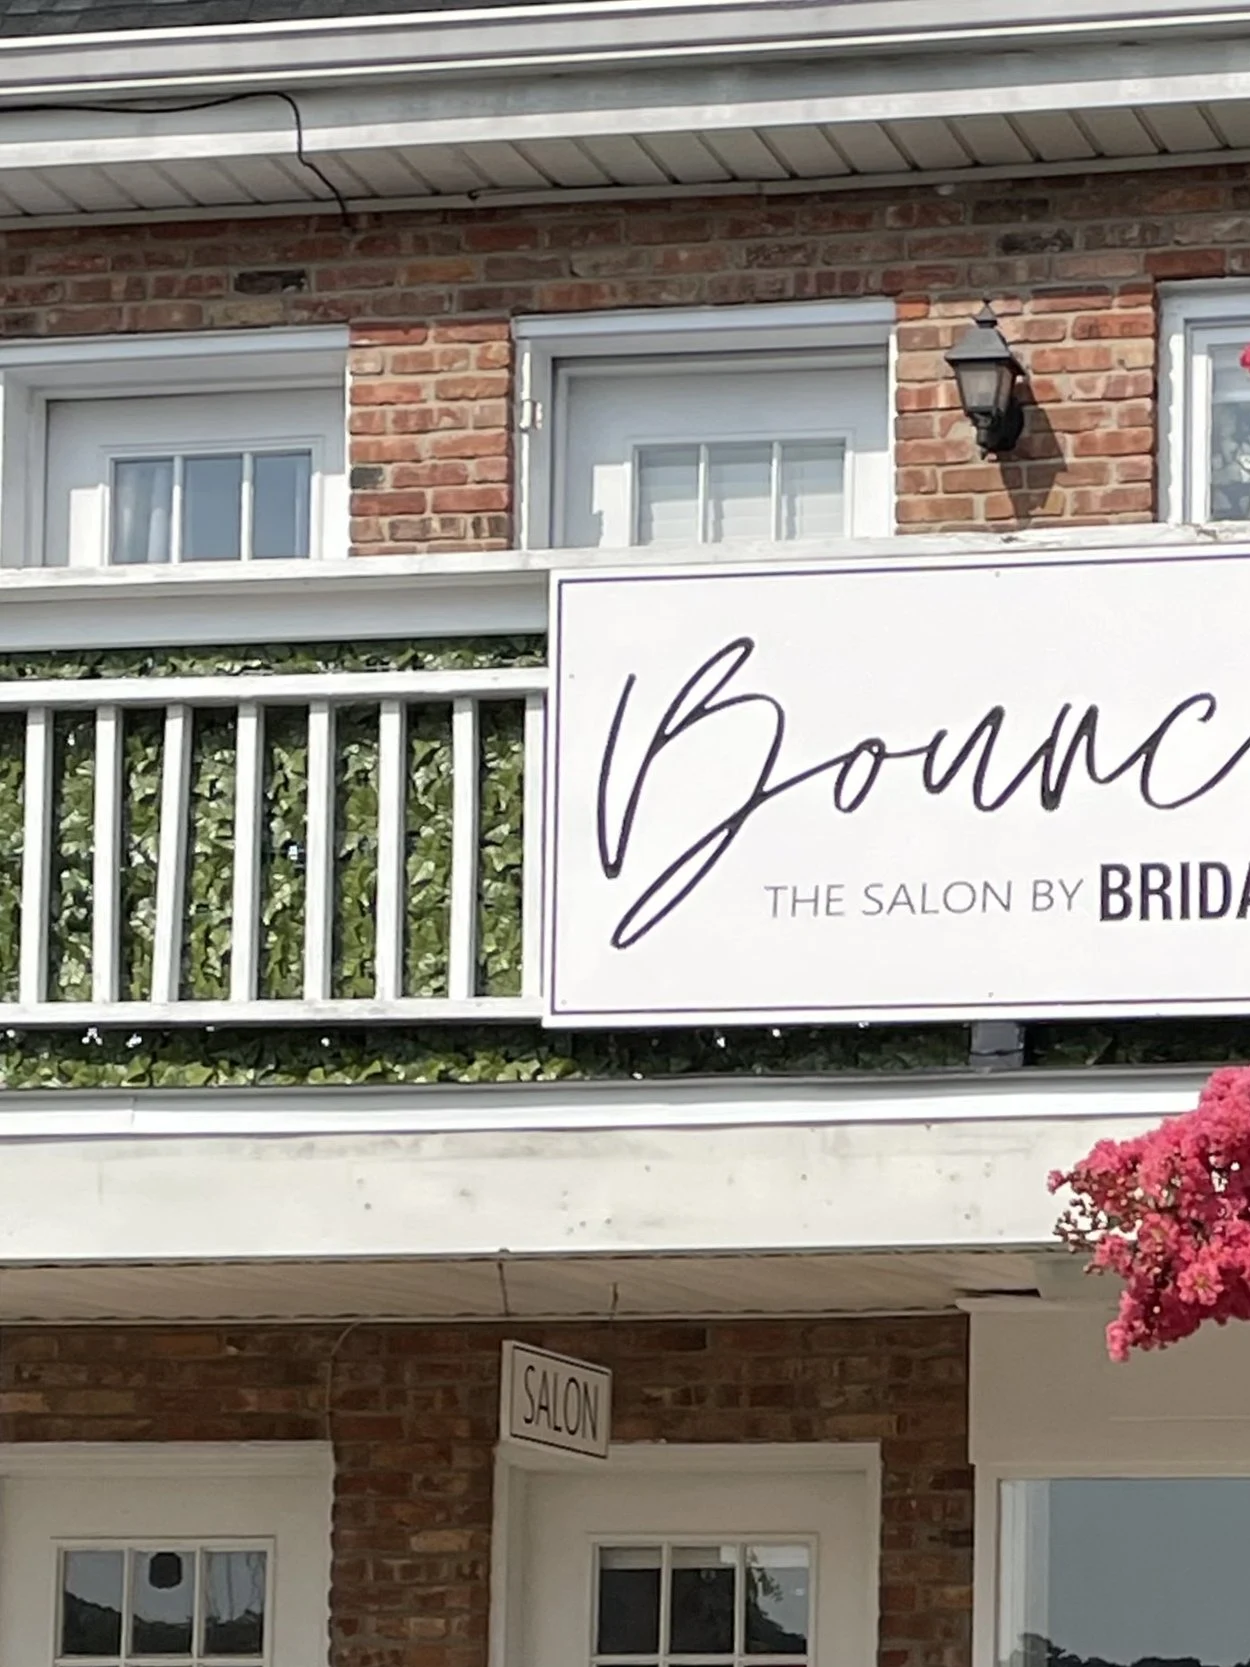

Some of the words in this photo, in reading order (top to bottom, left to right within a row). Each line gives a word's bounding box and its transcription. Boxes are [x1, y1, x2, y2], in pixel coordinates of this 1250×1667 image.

[763, 883, 846, 918] THE
[861, 879, 1012, 917] SALON
[1031, 877, 1084, 912] BY
[523, 1364, 599, 1442] SALON
